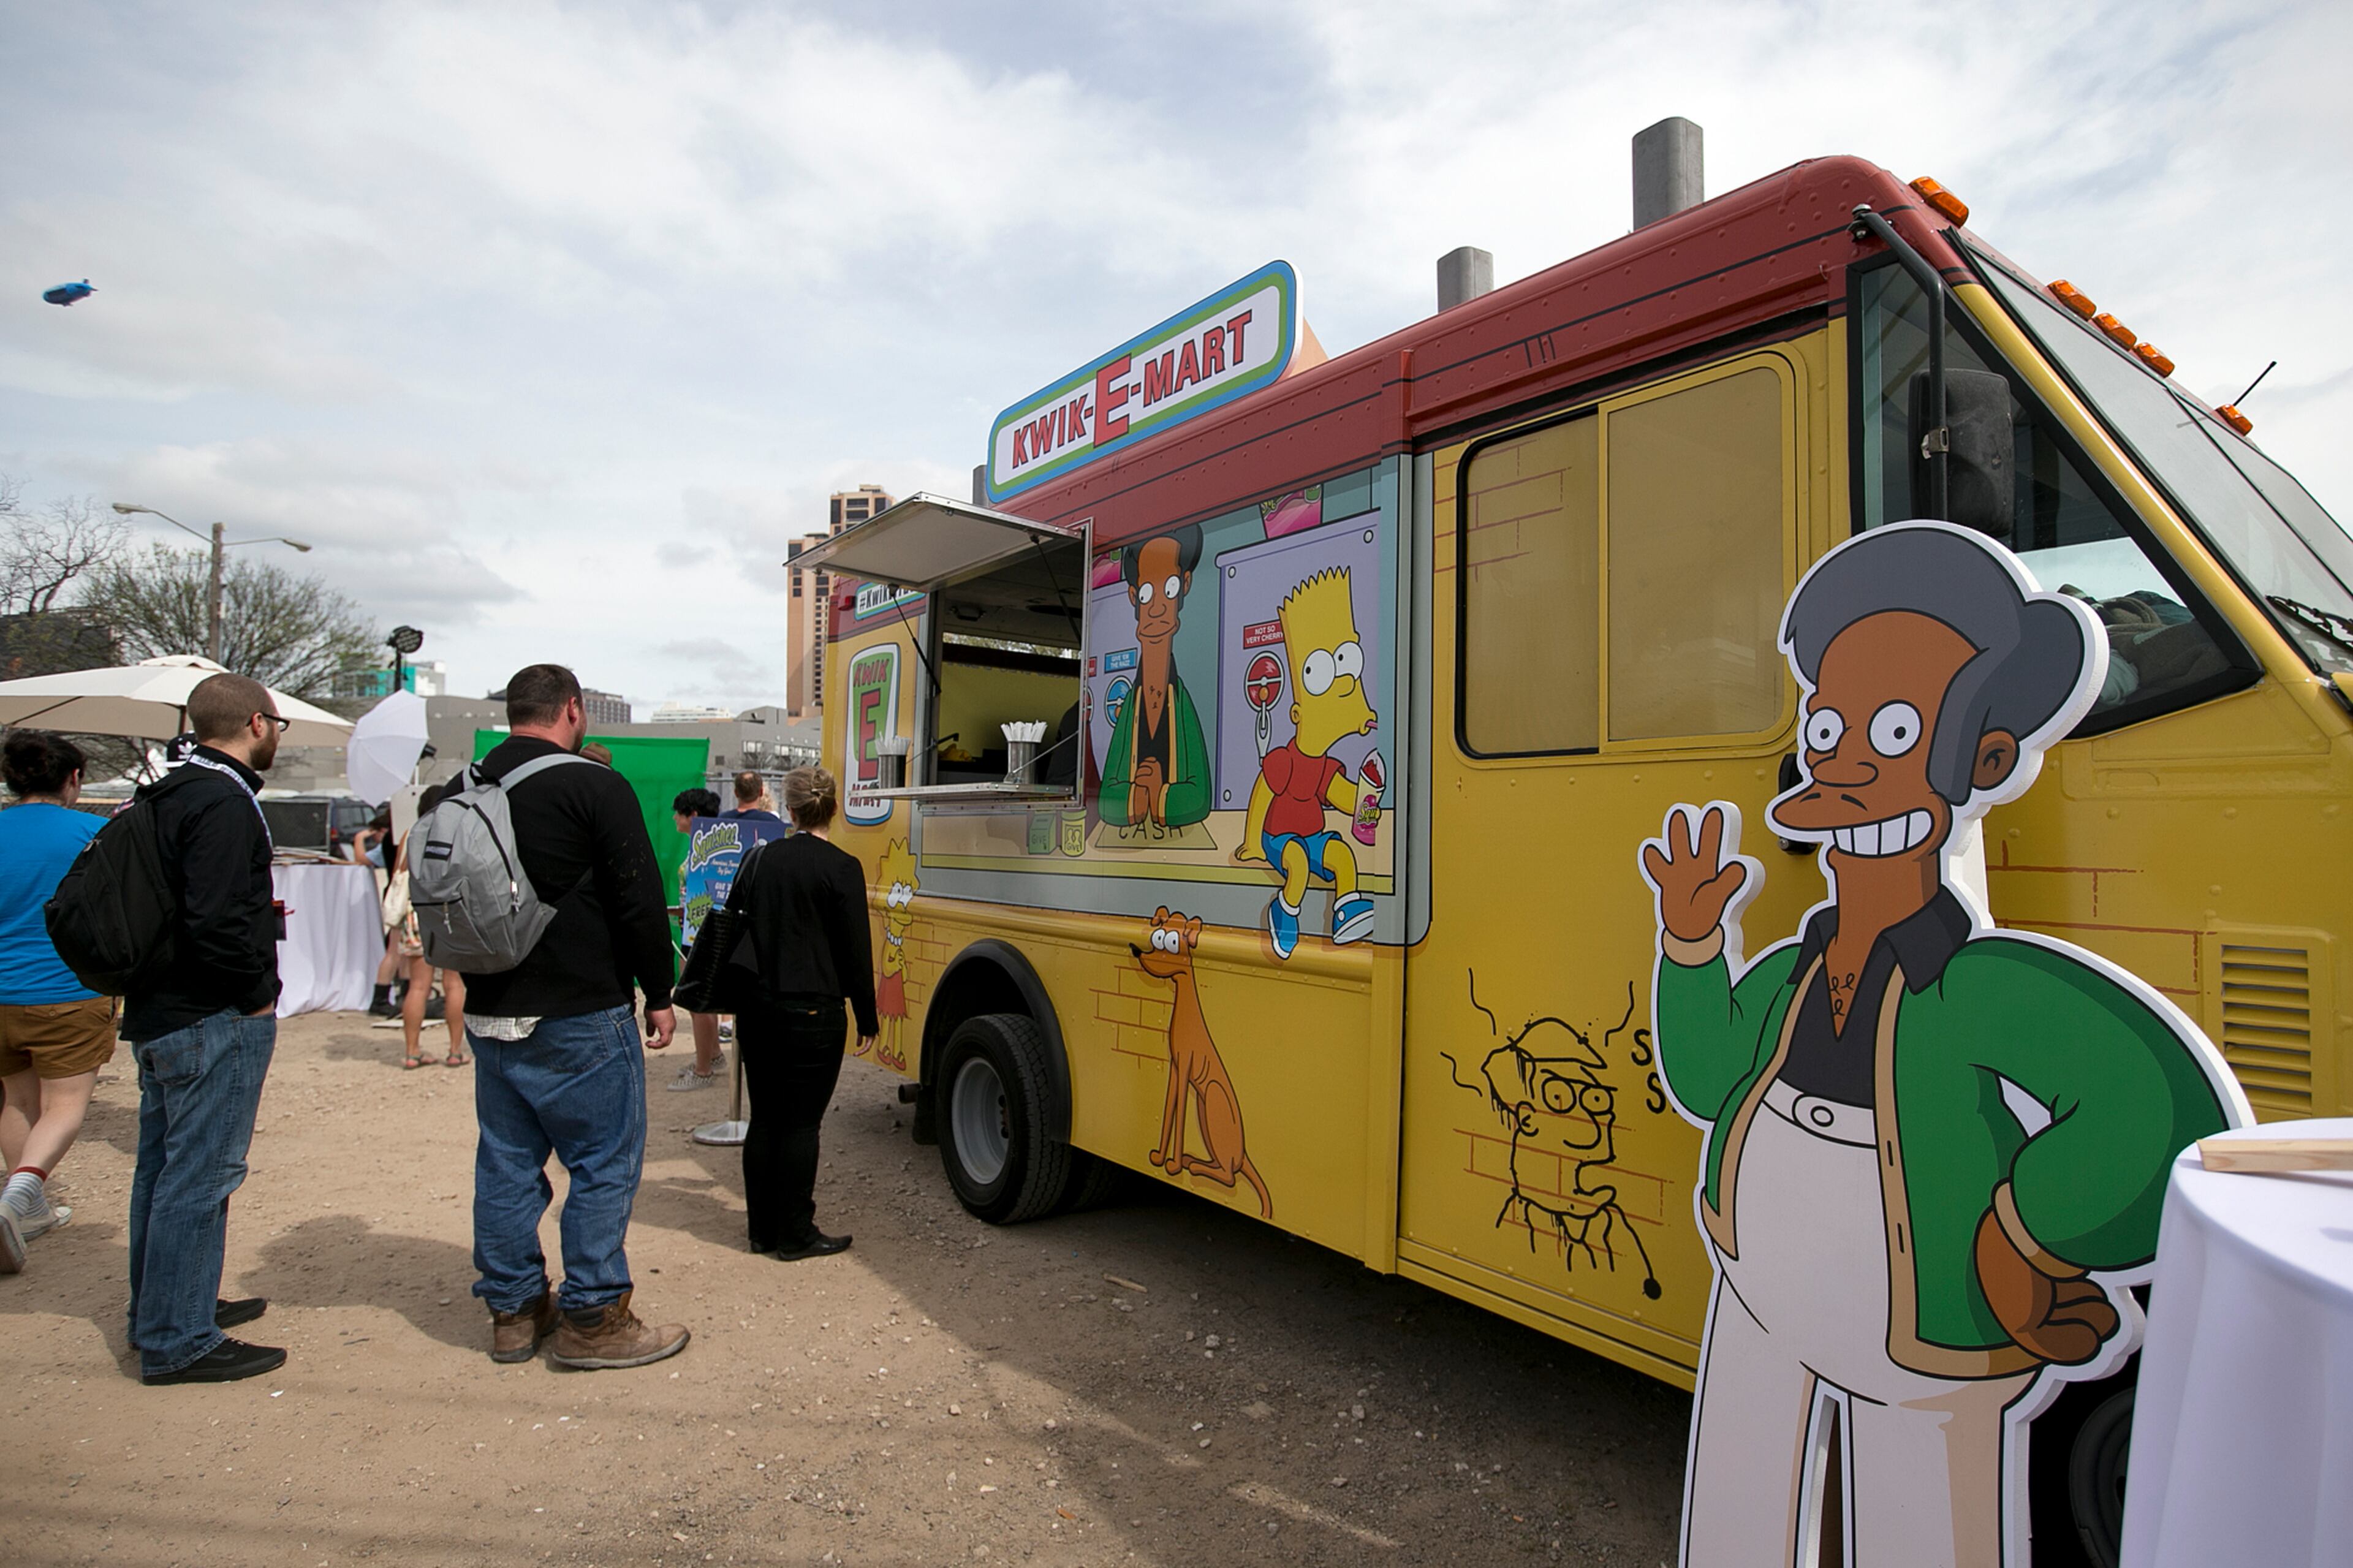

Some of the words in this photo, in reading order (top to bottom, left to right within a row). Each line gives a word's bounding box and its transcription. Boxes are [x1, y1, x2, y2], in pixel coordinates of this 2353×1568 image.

[1012, 309, 1253, 469] KWIK-E-MART
[1267, 624, 1275, 633] SO
[1261, 632, 1283, 642] CHERRY
[853, 659, 890, 687] KWIK
[858, 687, 881, 781] E
[1119, 823, 1183, 839] CASH
[1066, 843, 1080, 852] GIVE
